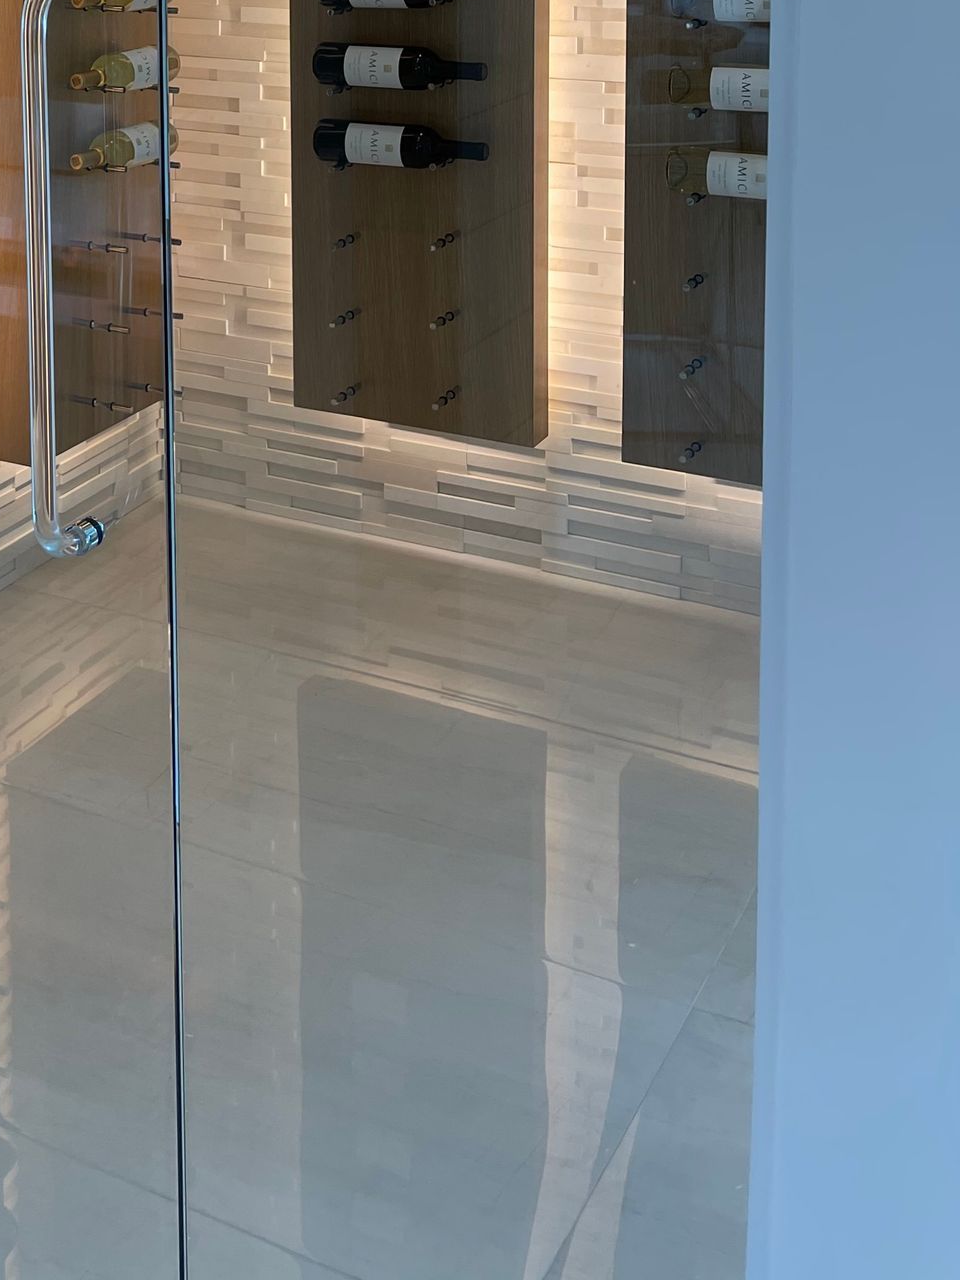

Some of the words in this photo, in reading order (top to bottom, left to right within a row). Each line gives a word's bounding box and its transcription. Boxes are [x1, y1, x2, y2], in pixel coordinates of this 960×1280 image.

[368, 50, 379, 85] AMICI
[741, 72, 753, 109] AMICI
[370, 129, 381, 163] AMICI
[737, 157, 748, 195] AMICI
